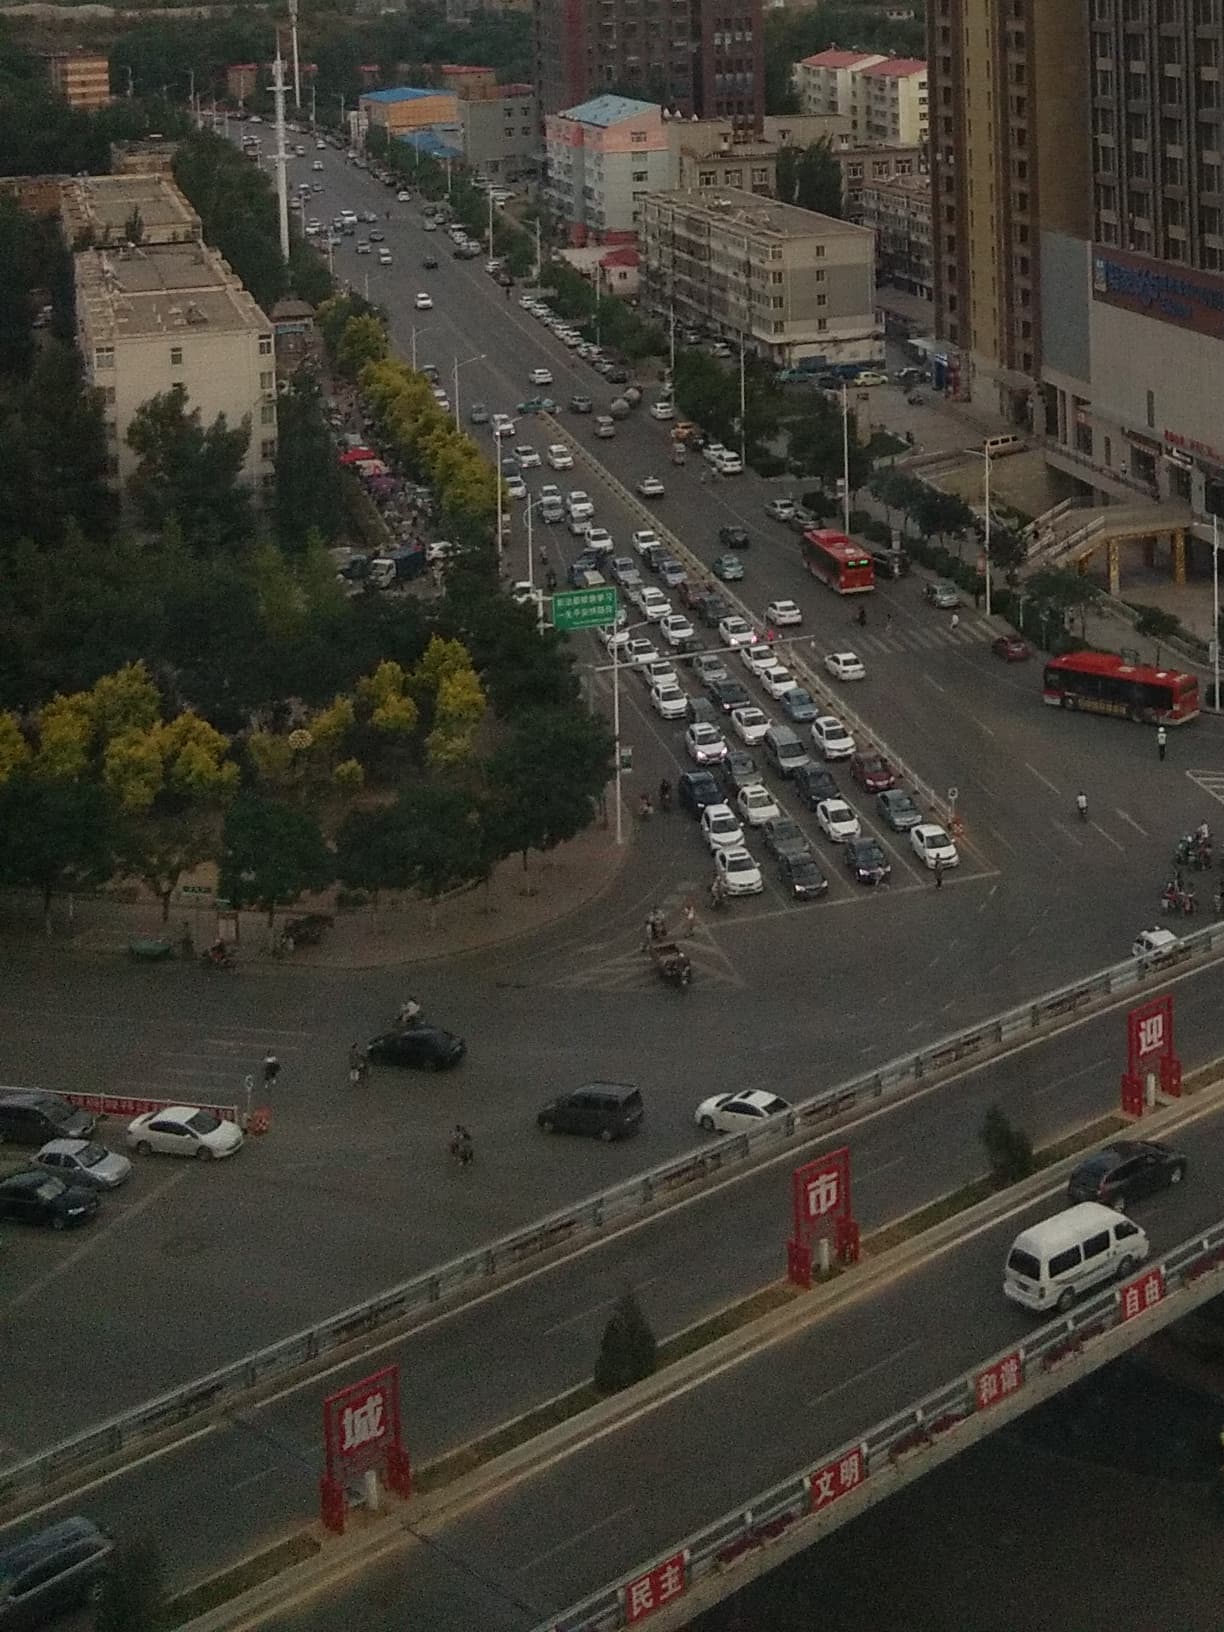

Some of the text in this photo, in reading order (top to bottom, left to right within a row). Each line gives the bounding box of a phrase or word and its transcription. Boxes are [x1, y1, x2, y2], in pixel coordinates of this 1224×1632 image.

[1138, 1014, 1164, 1056] 迎
[806, 1171, 839, 1217] 市
[1125, 1275, 1160, 1318] 自由
[979, 1358, 1019, 1405] 和谐
[342, 1392, 386, 1452] 城
[814, 1452, 860, 1506] 文明
[631, 1565, 683, 1618] 民主
